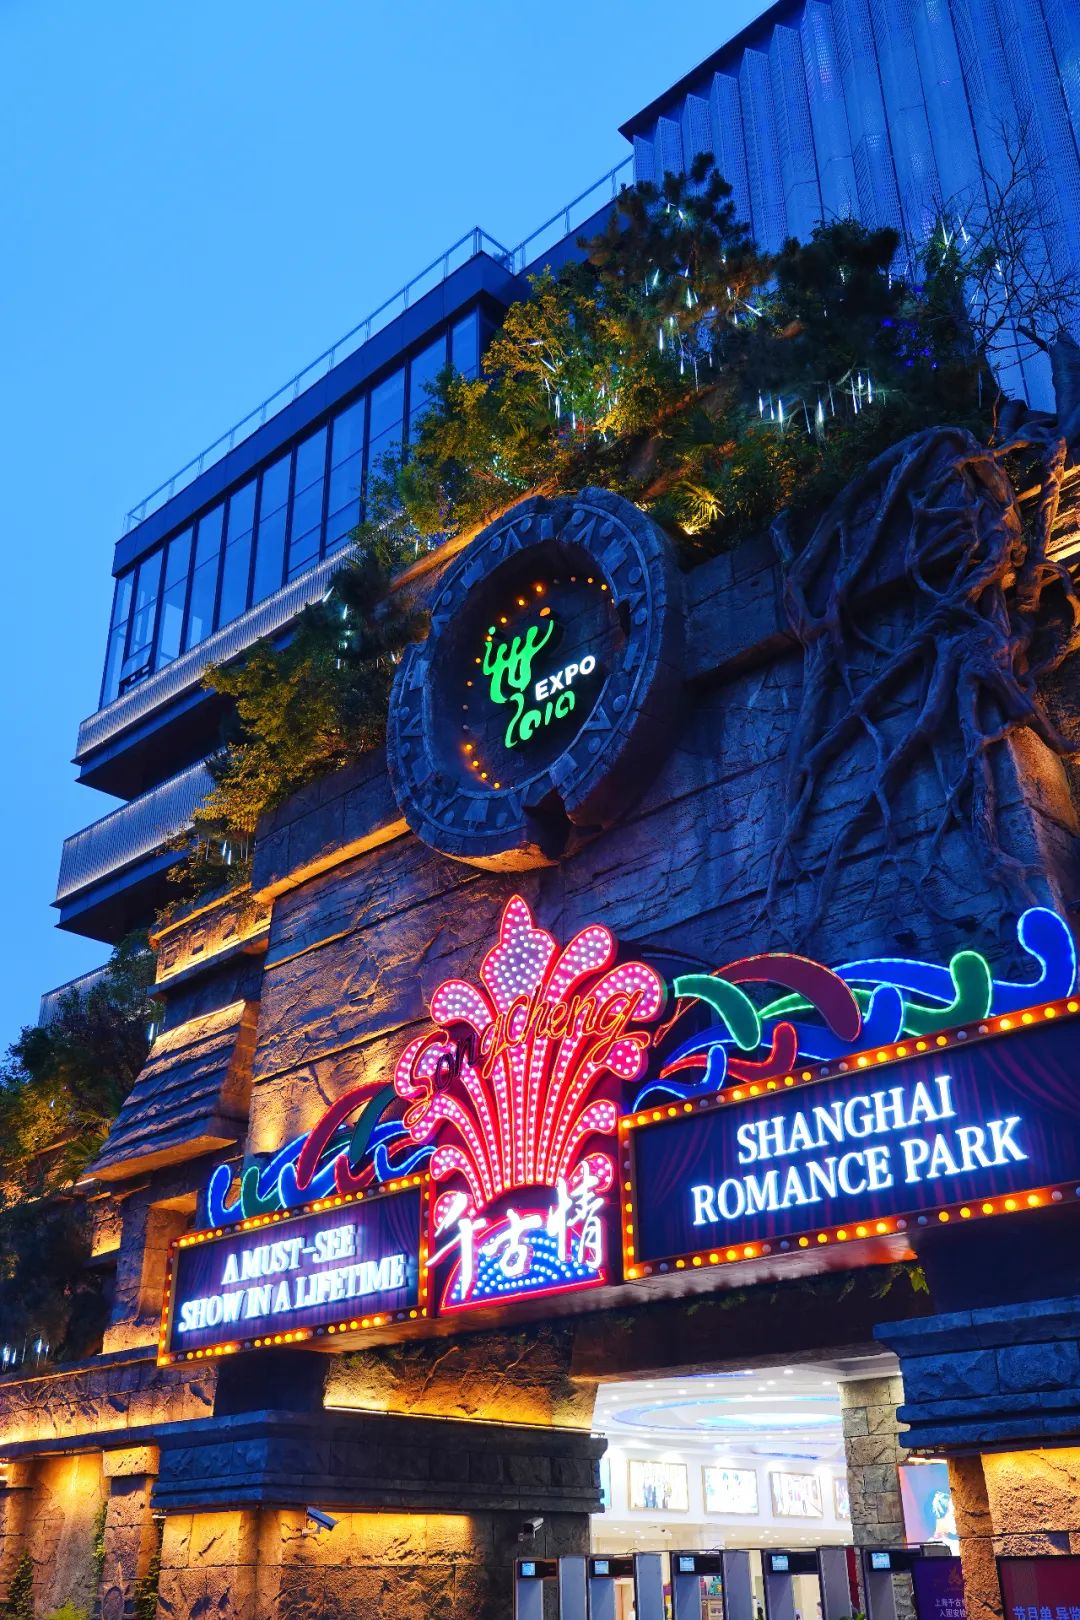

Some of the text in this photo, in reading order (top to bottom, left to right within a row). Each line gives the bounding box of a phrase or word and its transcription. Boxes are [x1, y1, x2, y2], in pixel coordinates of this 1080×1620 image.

[535, 655, 596, 701] EXPO
[505, 691, 575, 748] 2010
[737, 1075, 956, 1164] SHANGHAI
[691, 1116, 1028, 1226] ROMANCE PARK
[220, 1224, 357, 1286] A MUST-SEE
[425, 1160, 604, 1300] 千古情
[178, 1254, 406, 1332] SHOW IN A LIFETIME
